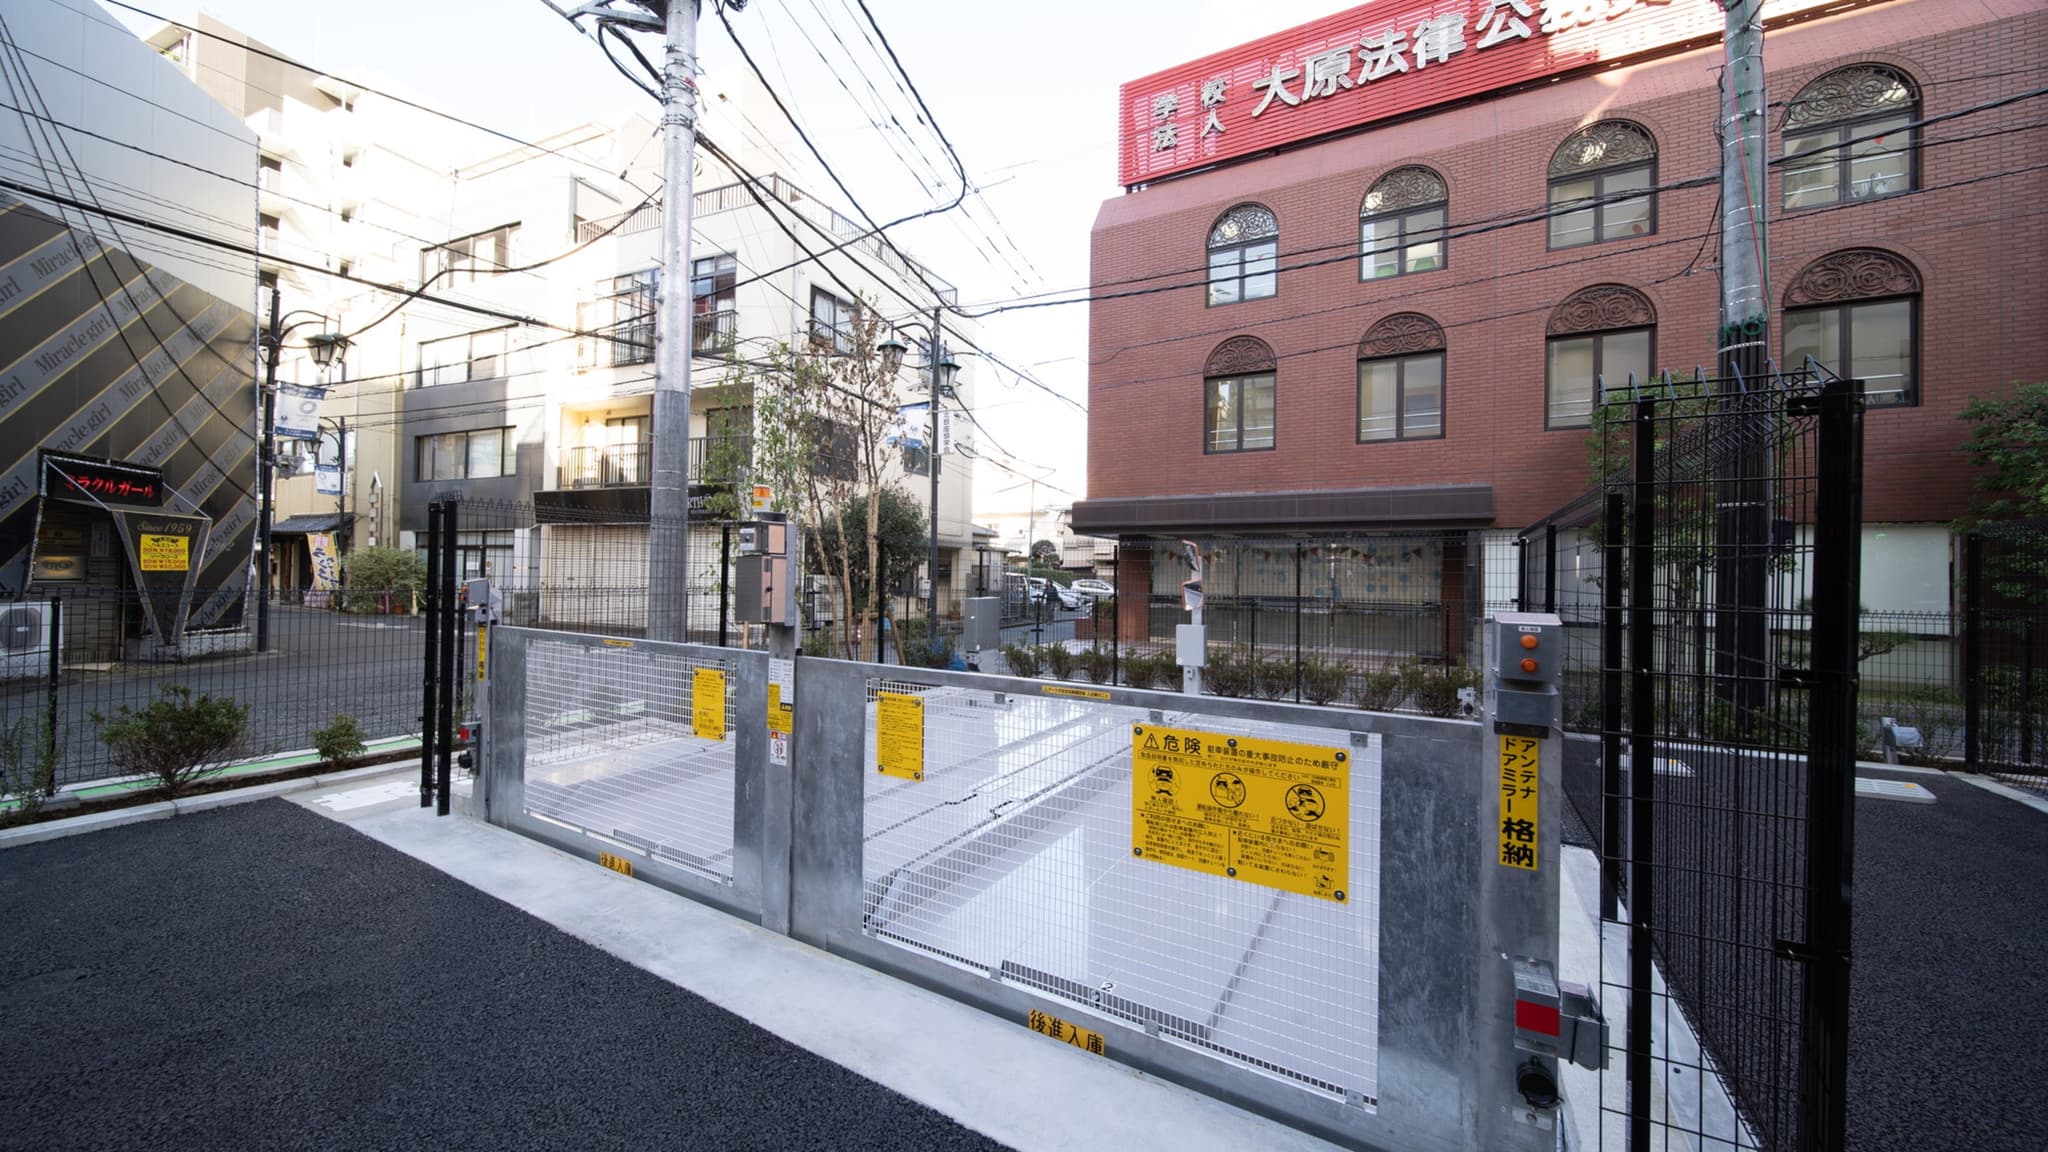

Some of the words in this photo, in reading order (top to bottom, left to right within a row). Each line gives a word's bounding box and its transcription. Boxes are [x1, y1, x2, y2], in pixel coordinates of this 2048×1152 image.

[1252, 0, 1672, 118] 大原法律公
[34, 332, 88, 377] Miracle
[86, 313, 112, 341] girl
[87, 402, 113, 432] girl
[65, 473, 154, 498] ミラクルガール
[1163, 733, 1200, 755] 危険
[1519, 739, 1537, 800] アンテナ
[1501, 737, 1518, 813] ドアミラー
[1501, 816, 1536, 868] 格納
[1029, 1009, 1104, 1057] 後進入庫
